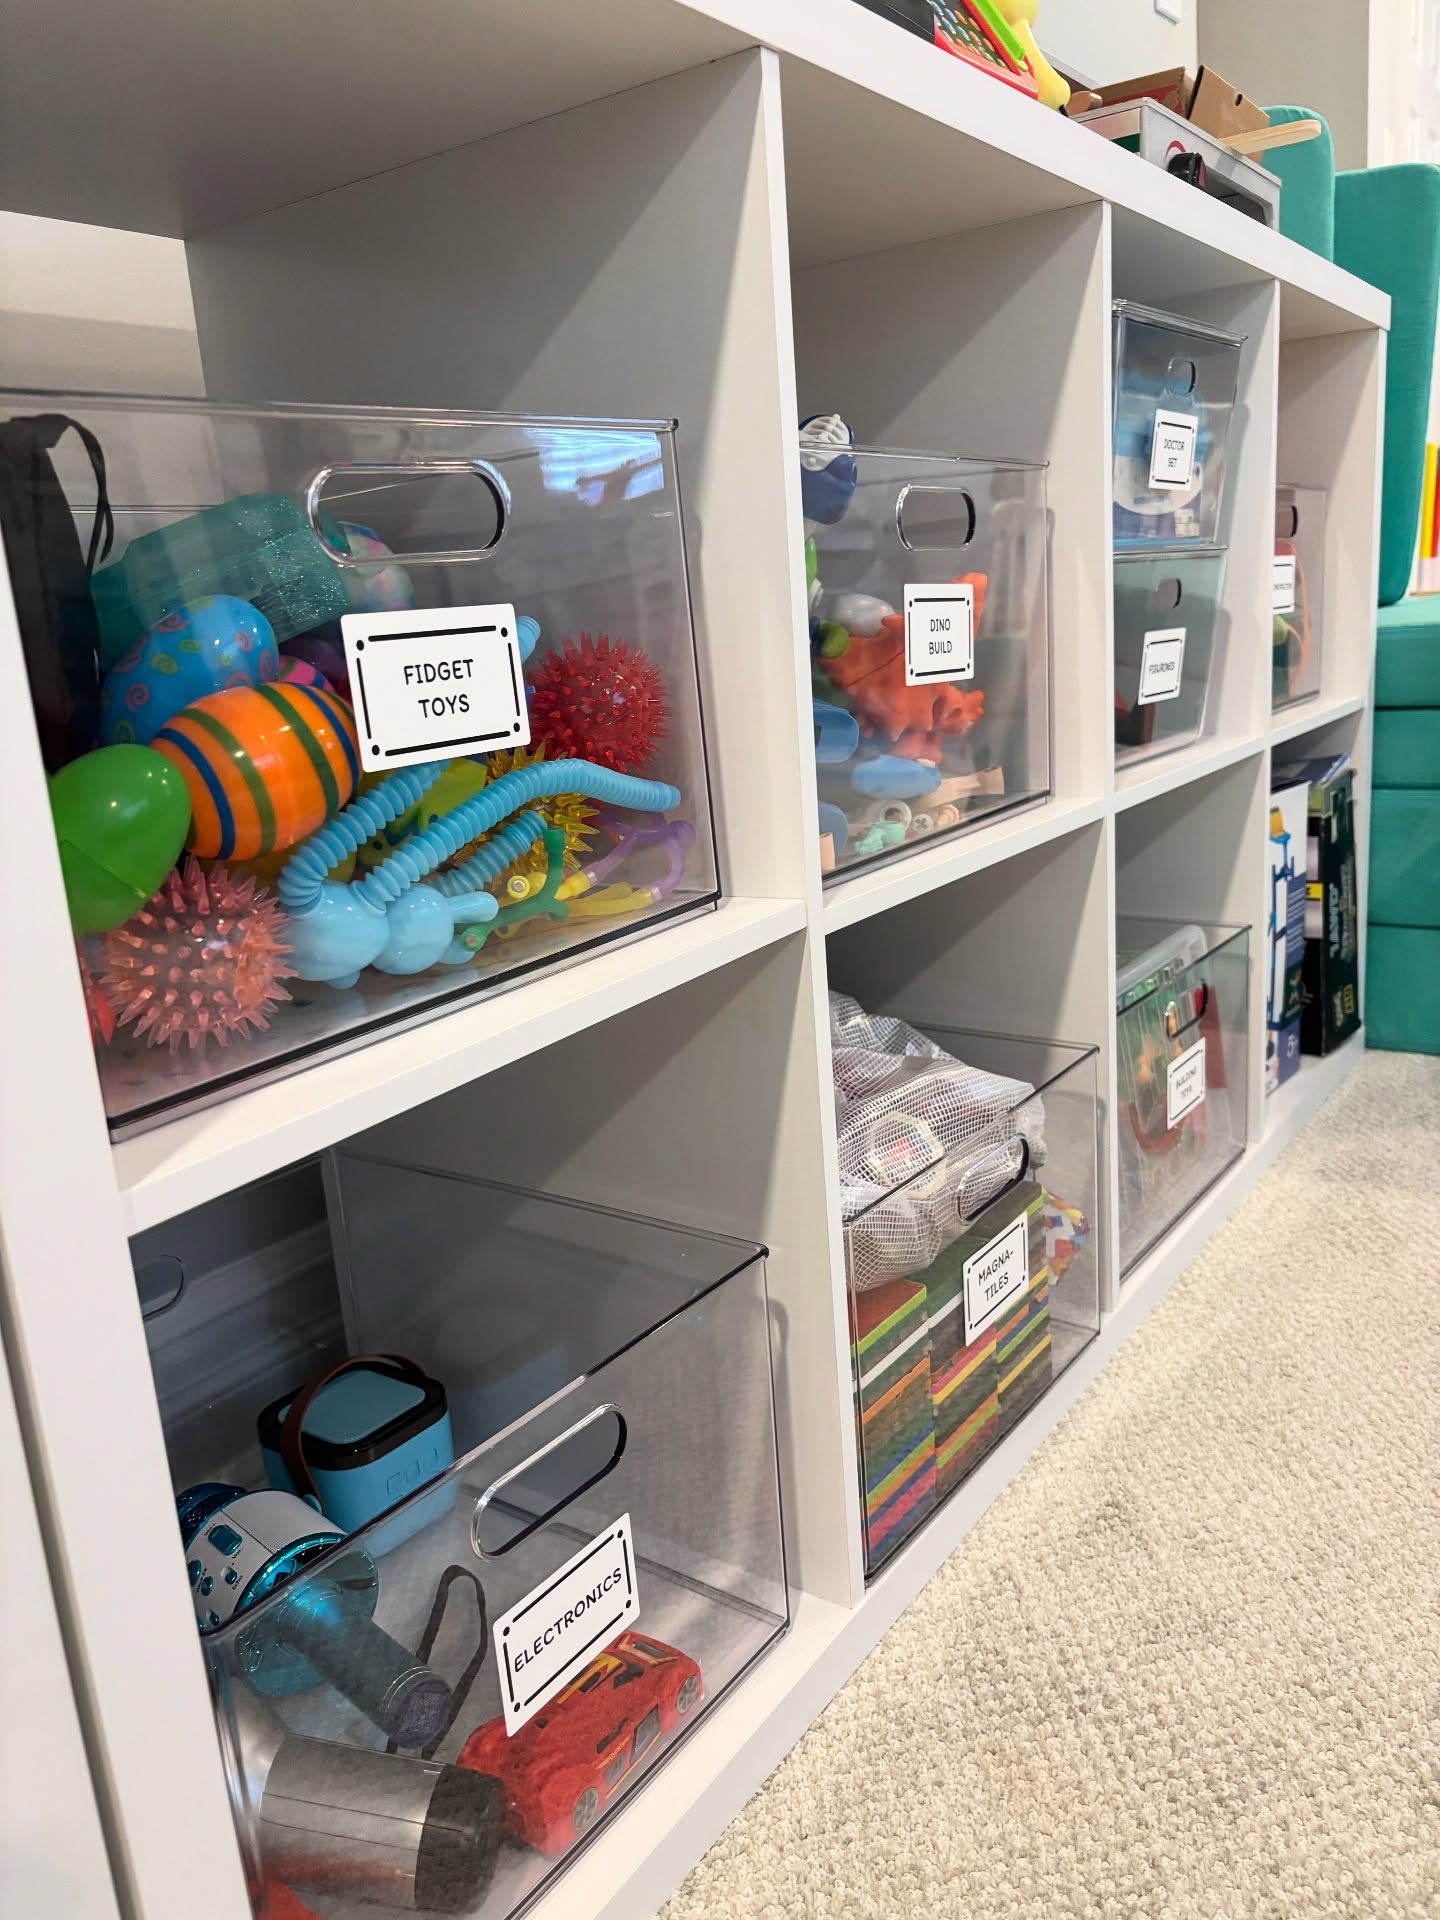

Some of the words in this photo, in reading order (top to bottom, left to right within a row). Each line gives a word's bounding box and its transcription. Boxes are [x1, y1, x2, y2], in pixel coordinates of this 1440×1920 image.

[1163, 438, 1185, 451] DOCTOR
[1167, 457, 1178, 468] SET
[929, 618, 951, 632] DINO
[928, 640, 953, 655] BUILD
[403, 658, 474, 686] FIDGET
[417, 693, 470, 718] TOYS
[978, 1249, 1014, 1286] MAGNA-
[984, 1271, 1009, 1301] TILES
[513, 1567, 622, 1673] ELECTRONICS
